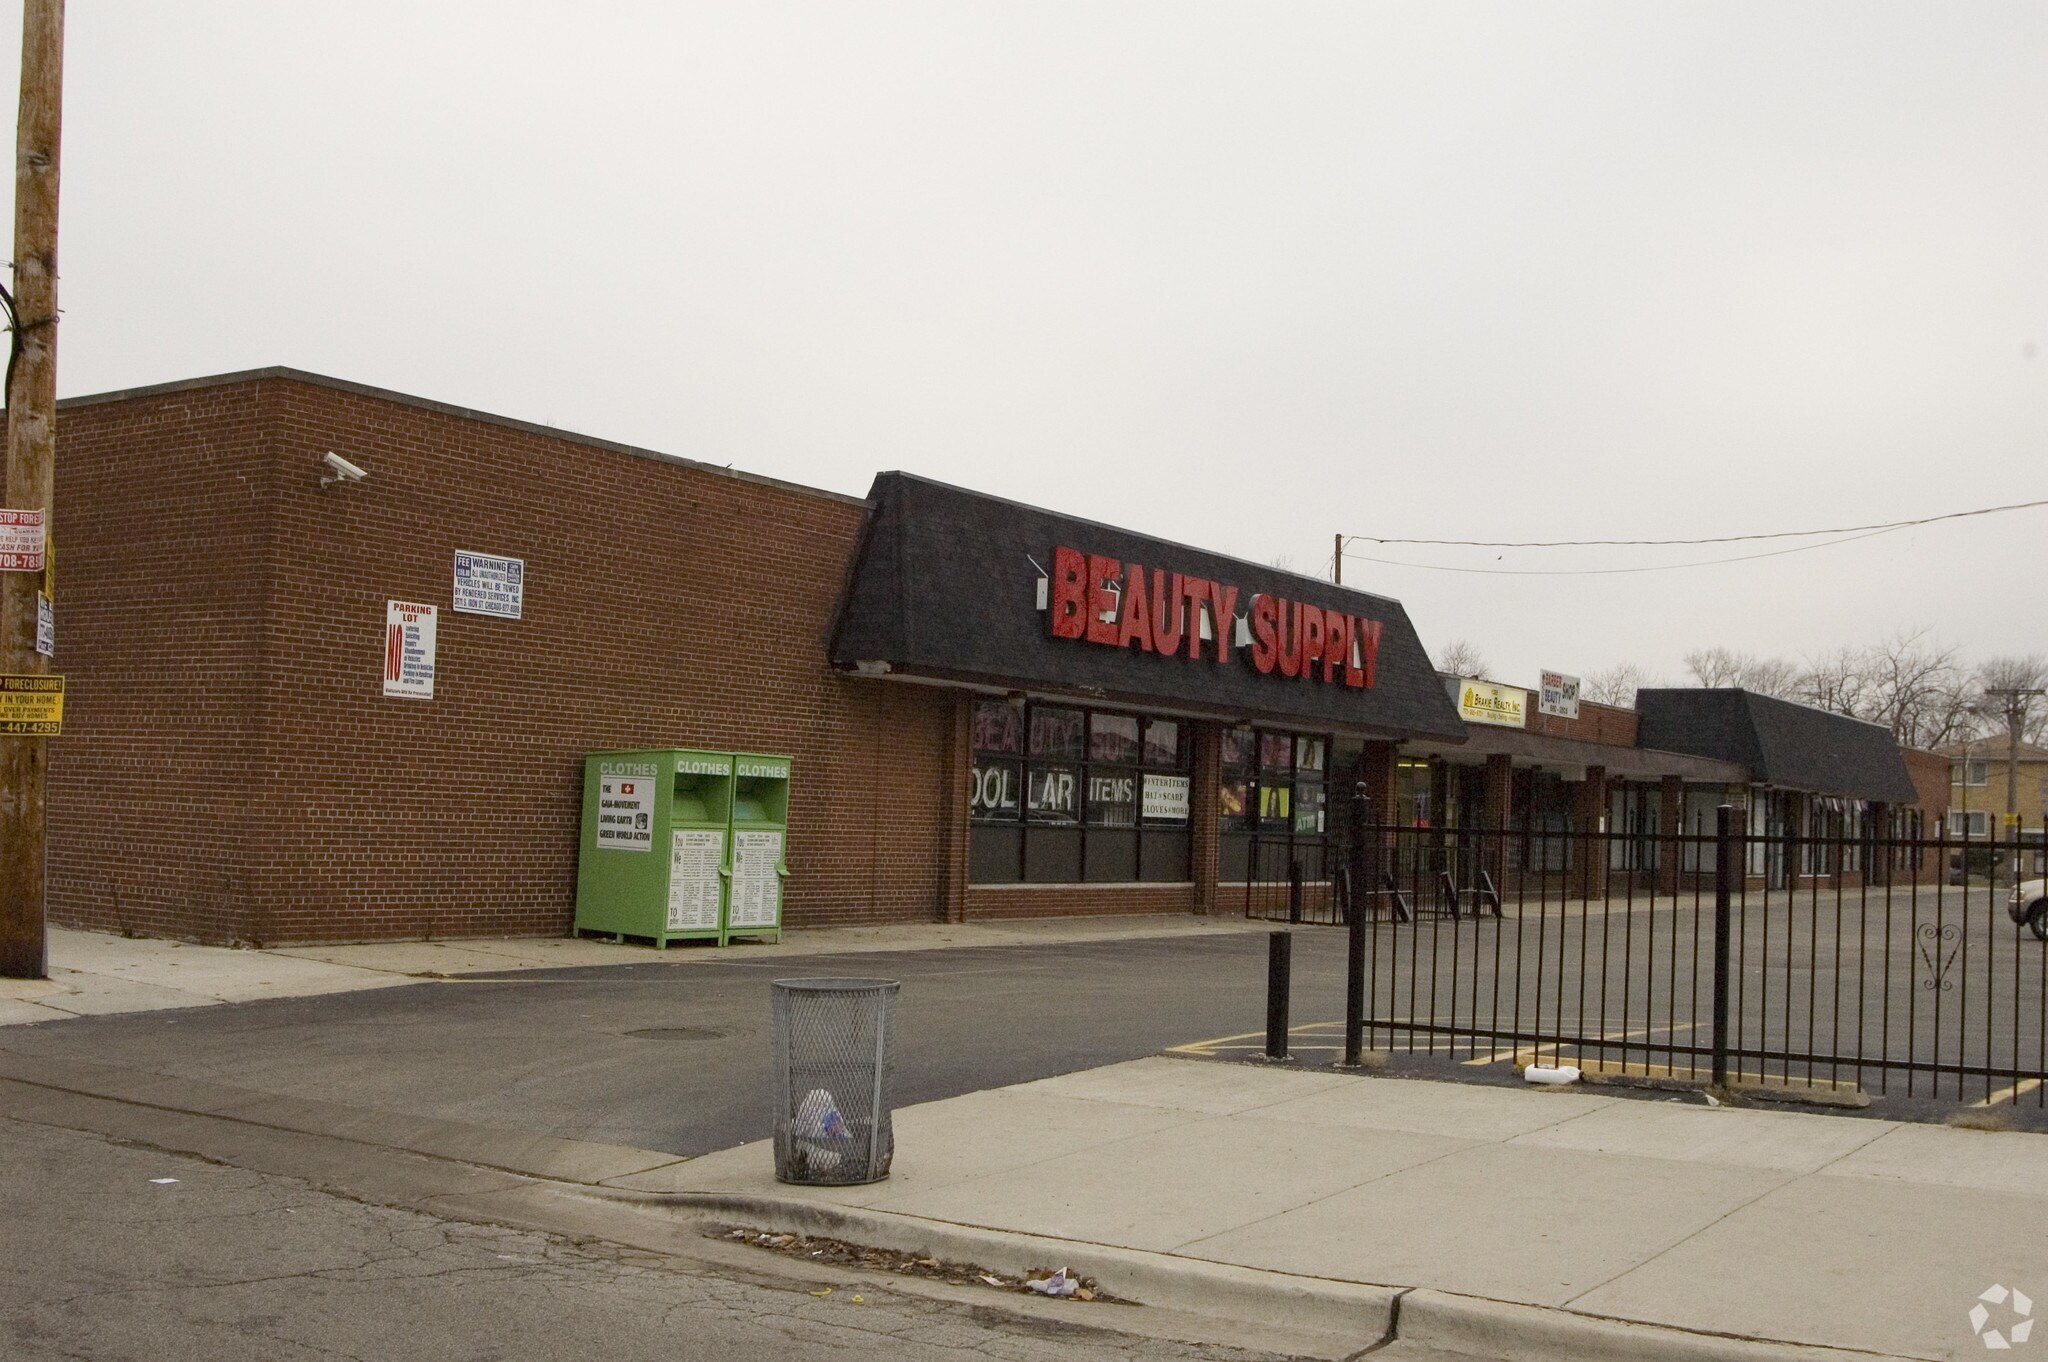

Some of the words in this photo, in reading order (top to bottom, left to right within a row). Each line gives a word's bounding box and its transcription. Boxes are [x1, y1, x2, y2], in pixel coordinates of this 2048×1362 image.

[0, 512, 17, 524] STOP
[17, 544, 30, 552] FOR
[457, 556, 470, 568] FEE
[472, 557, 506, 572] WARNING
[457, 577, 480, 589] VEHICLES
[482, 580, 493, 591] WILL
[495, 582, 501, 592] BE
[503, 583, 519, 594] TOWED
[455, 587, 461, 596] BY
[462, 588, 487, 599] RENDERED
[393, 602, 432, 616] PARKING
[402, 613, 418, 623] LOT
[1052, 546, 1239, 664] BEAUTY
[1251, 592, 1384, 690] SUPPLY
[386, 623, 403, 682] NO
[5, 678, 61, 691] FORECLOSURE!
[5, 695, 13, 704] IN
[15, 695, 34, 705] YOUR
[36, 695, 57, 705] HOME
[600, 762, 658, 776] CLOTHES
[677, 761, 729, 776] CLOTHES
[738, 764, 787, 779] CLOTHES
[602, 784, 612, 794] THE
[1090, 776, 1133, 803] ITEMS
[1145, 791, 1158, 800] HAT
[1163, 792, 1184, 802] SCARF
[600, 814, 616, 824] LIVING
[599, 829, 615, 839] GREEN
[615, 830, 633, 840] WORLD
[633, 831, 651, 841] ACTION
